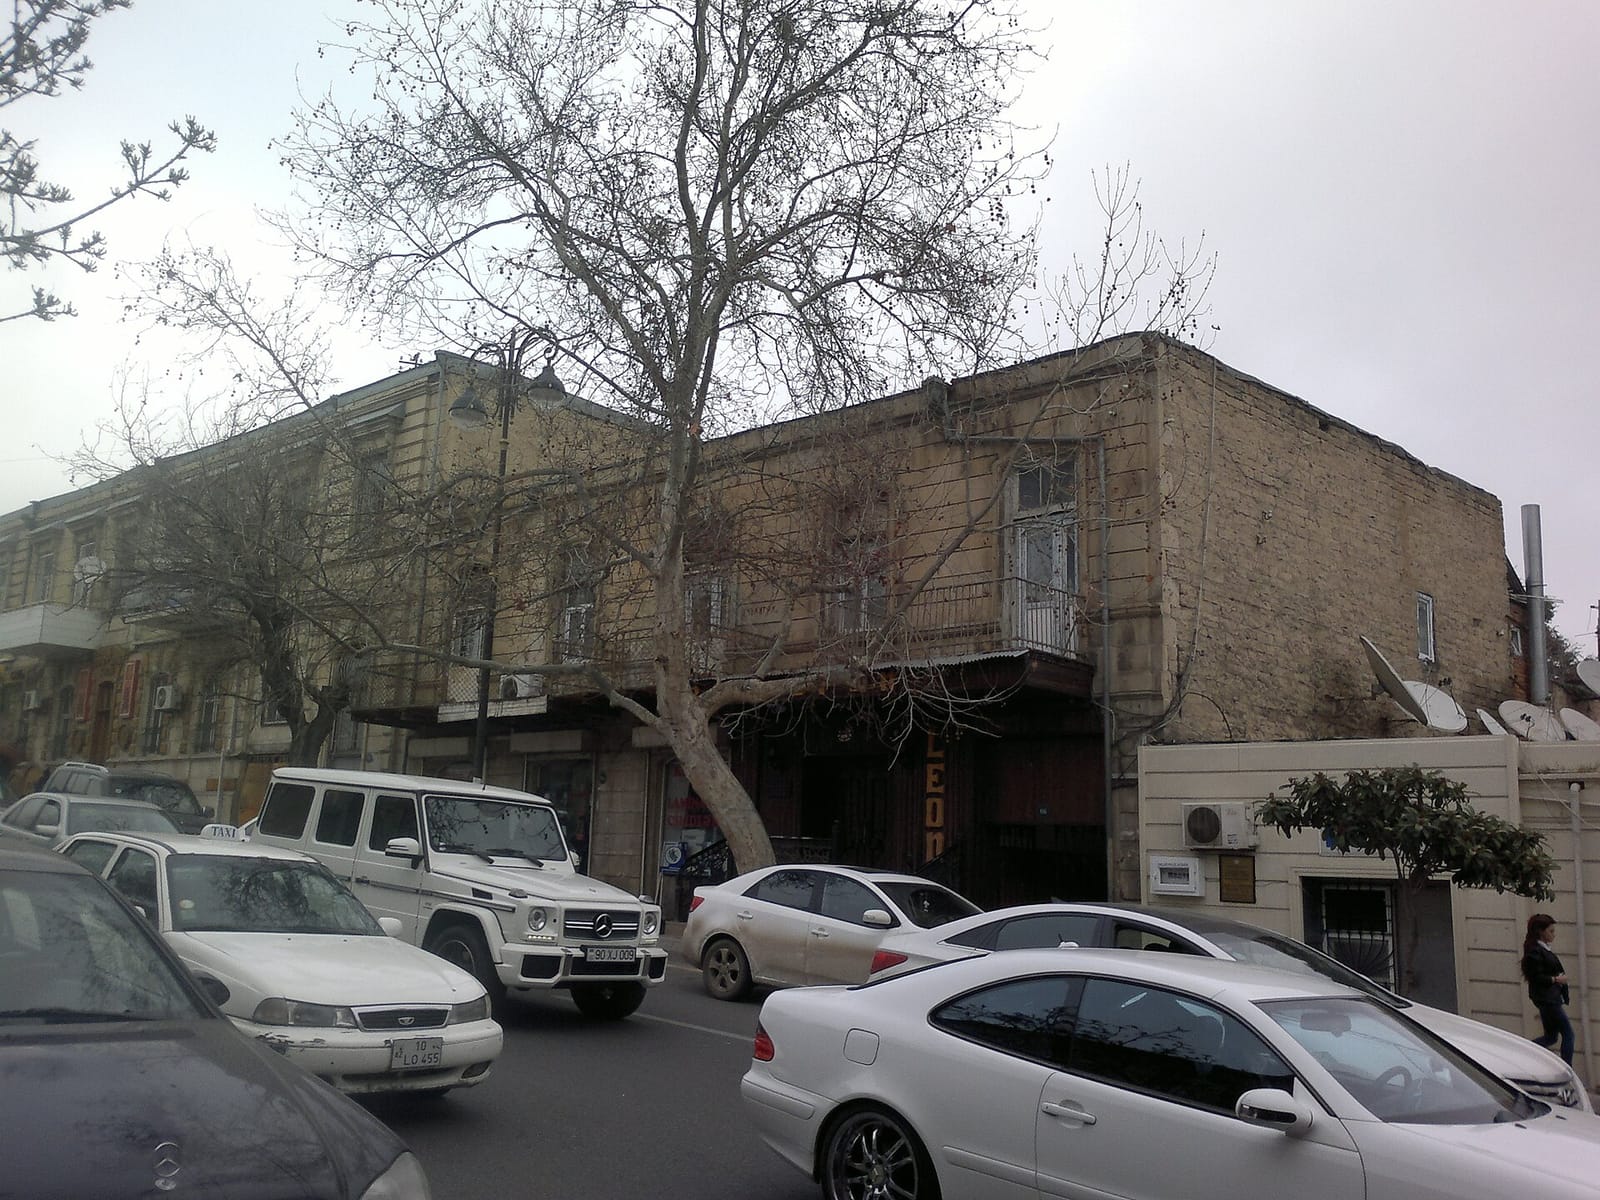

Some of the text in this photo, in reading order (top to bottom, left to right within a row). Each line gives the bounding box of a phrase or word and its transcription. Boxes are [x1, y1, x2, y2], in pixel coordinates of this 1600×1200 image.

[211, 826, 236, 838] TAXI
[415, 1040, 427, 1052] 10
[421, 1053, 439, 1064] 455
